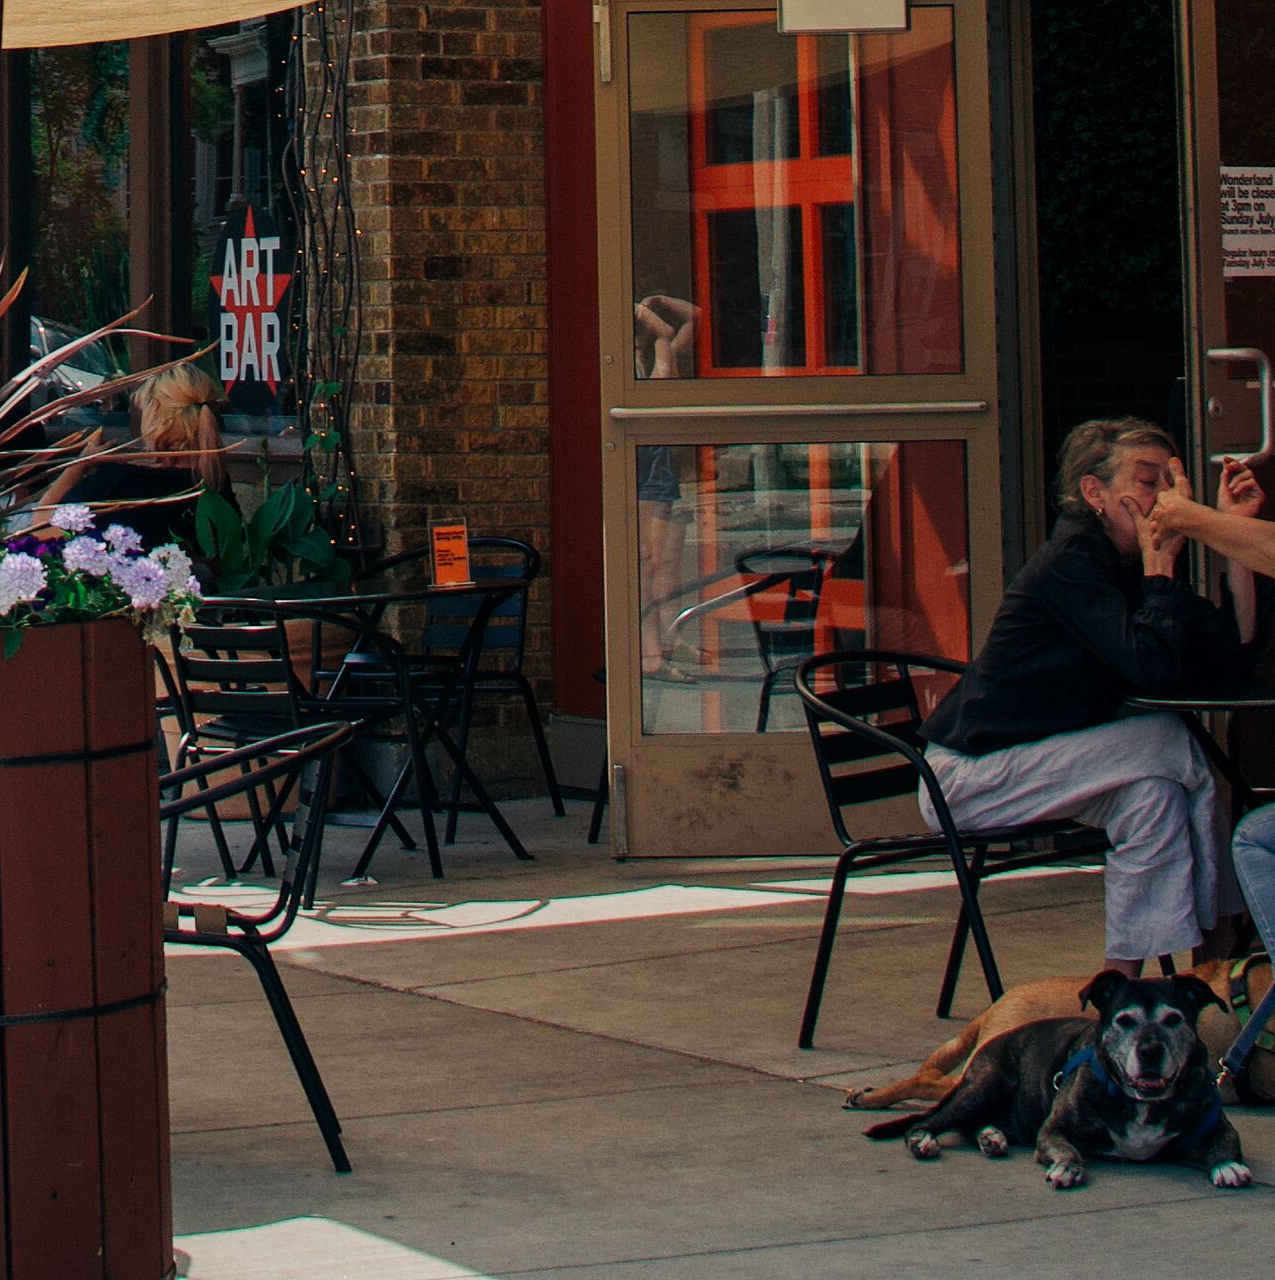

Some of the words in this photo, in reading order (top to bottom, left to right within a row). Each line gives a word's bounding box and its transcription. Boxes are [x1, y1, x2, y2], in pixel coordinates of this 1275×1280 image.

[1237, 186, 1249, 198] be
[1231, 199, 1252, 214] 3pm
[1253, 202, 1266, 211] on
[1220, 212, 1254, 228] Sunday
[1256, 212, 1274, 228] July
[220, 236, 280, 307] ART
[220, 312, 281, 382] BAR
